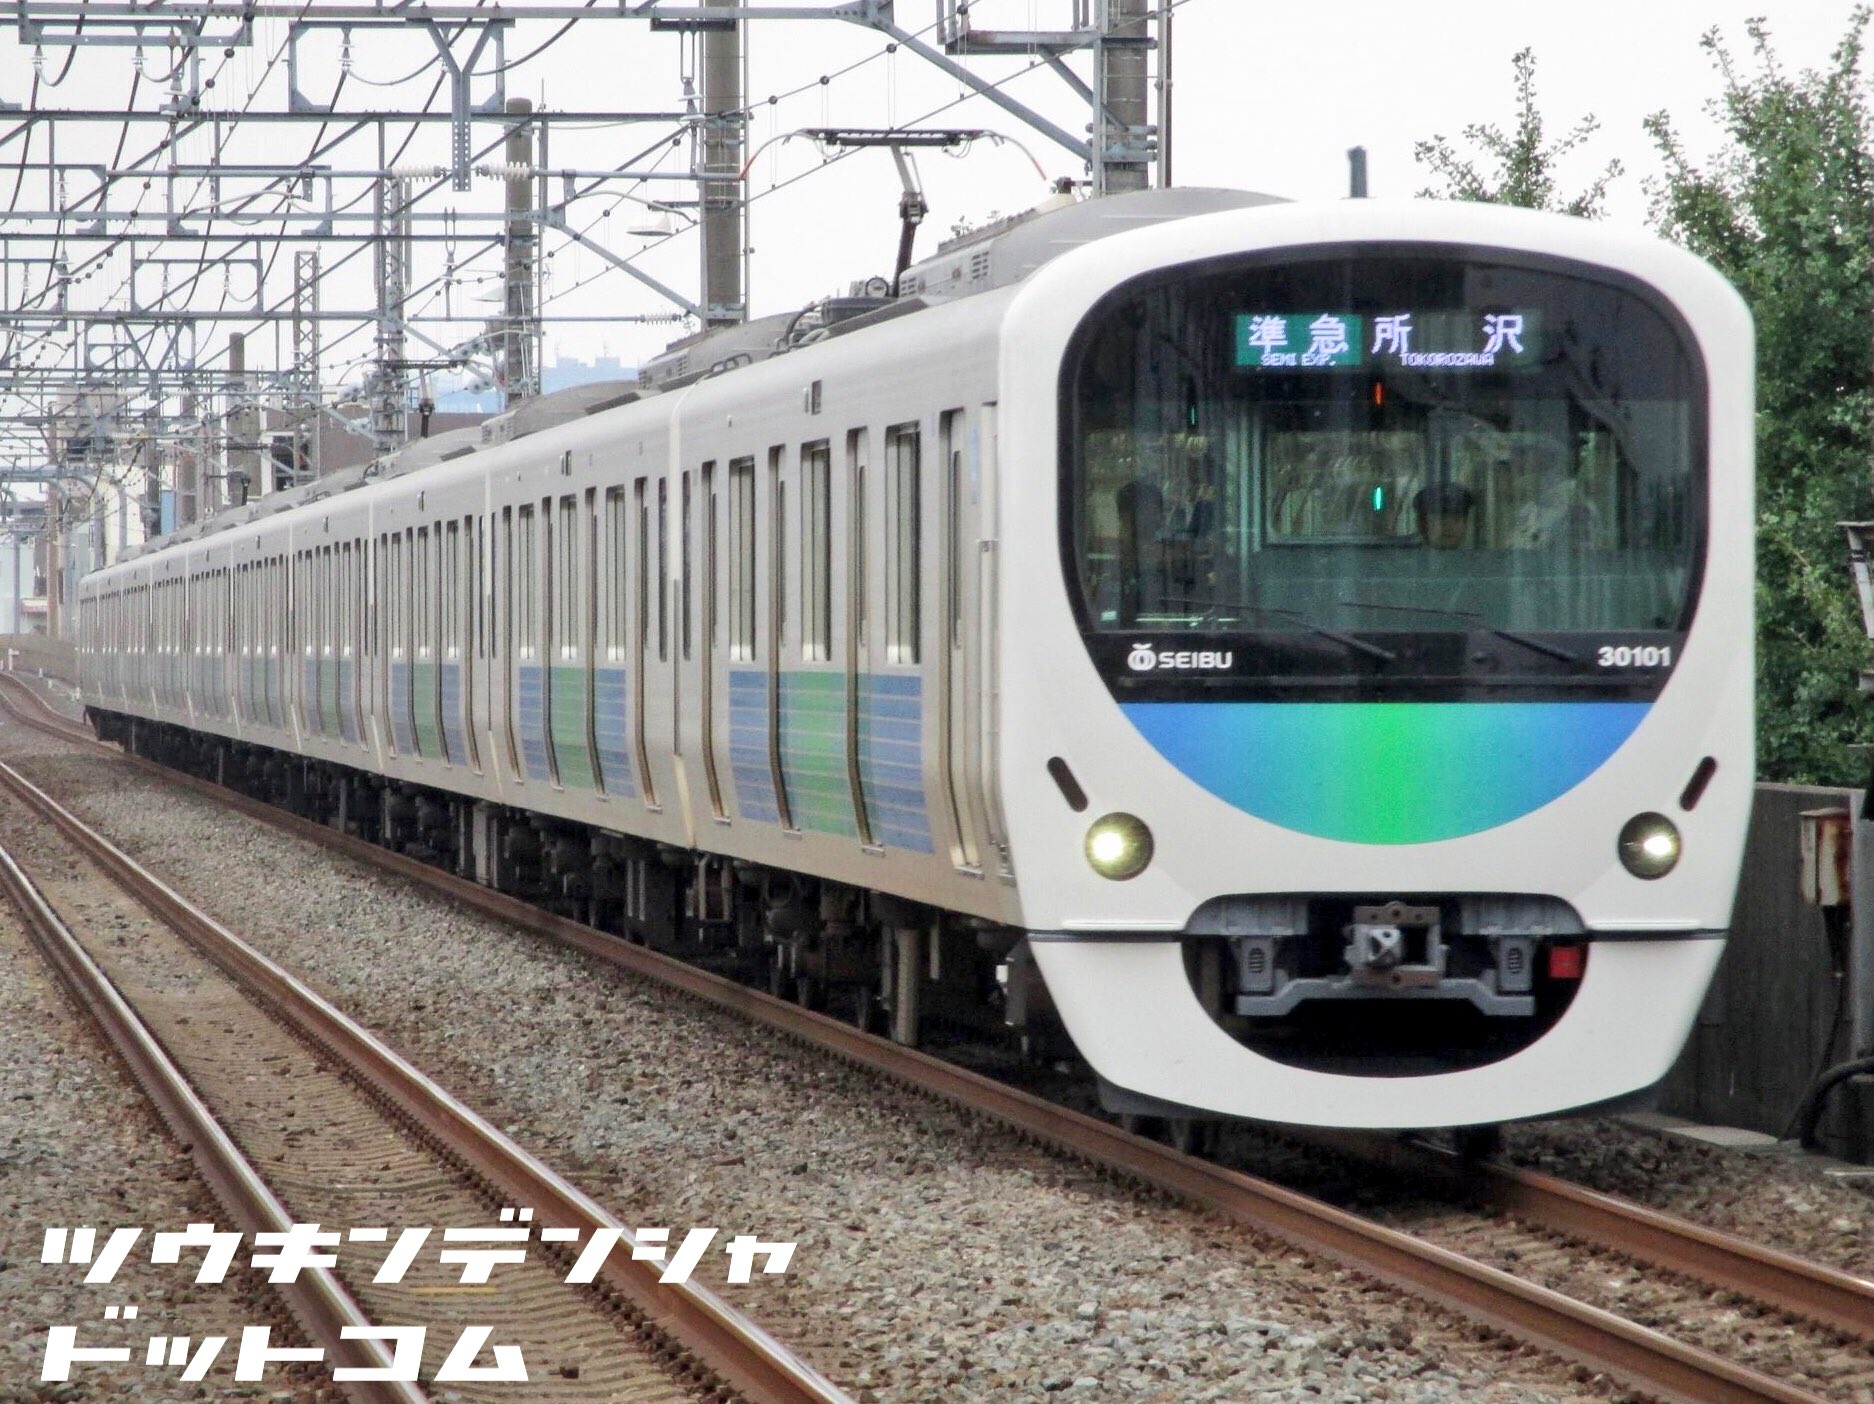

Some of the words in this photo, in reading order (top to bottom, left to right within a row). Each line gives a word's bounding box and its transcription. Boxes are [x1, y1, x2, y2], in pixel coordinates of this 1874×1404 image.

[1248, 313, 1349, 353] 準急
[1371, 313, 1524, 354] 所沢
[1261, 352, 1298, 367] SEMI
[1399, 352, 1495, 367] TOKOROZAWA
[1158, 651, 1233, 669] SEIBU
[1597, 645, 1672, 667] 30101
